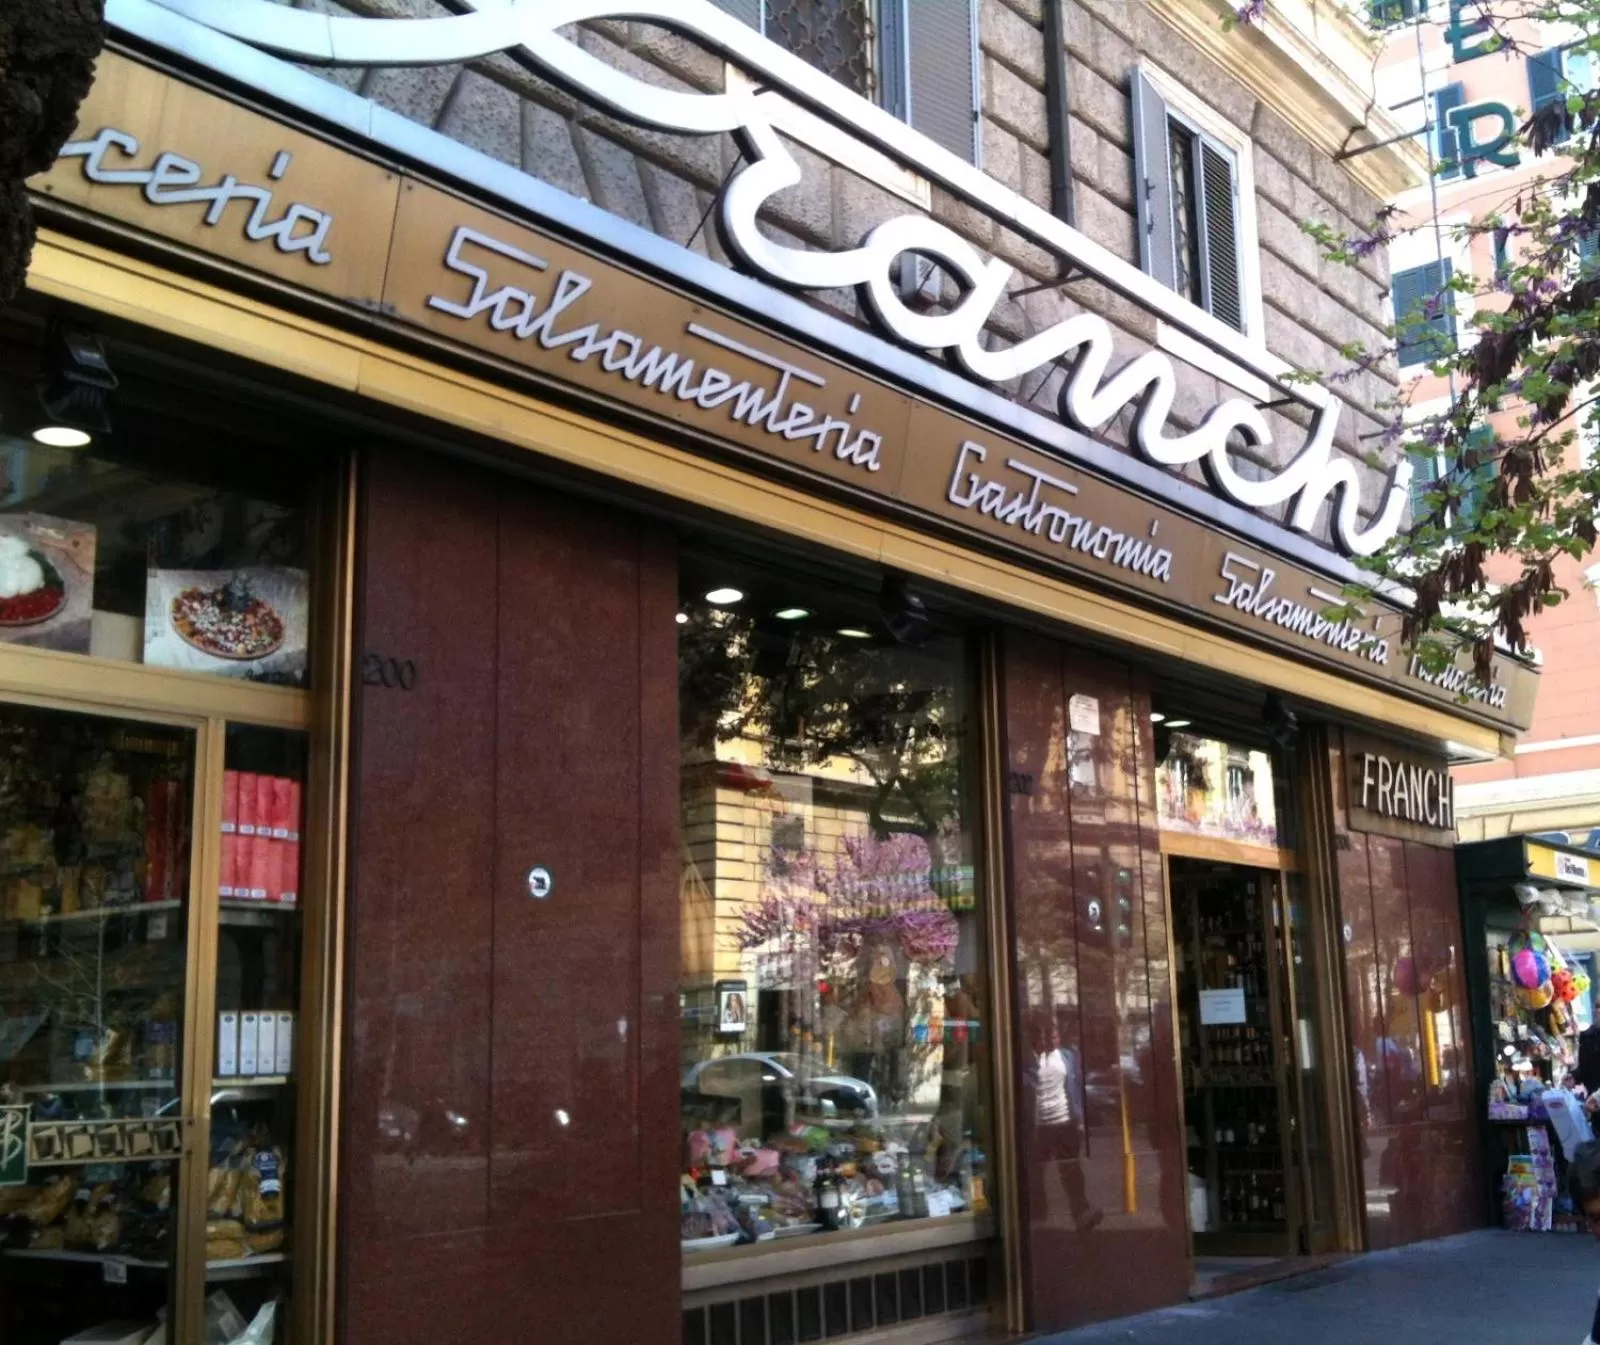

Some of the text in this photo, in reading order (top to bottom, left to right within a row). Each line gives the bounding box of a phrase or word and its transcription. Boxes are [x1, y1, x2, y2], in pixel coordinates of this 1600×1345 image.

[59, 128, 331, 265] ceria
[428, 226, 880, 471] Salsamenteria
[947, 441, 1171, 582] Gastronomia
